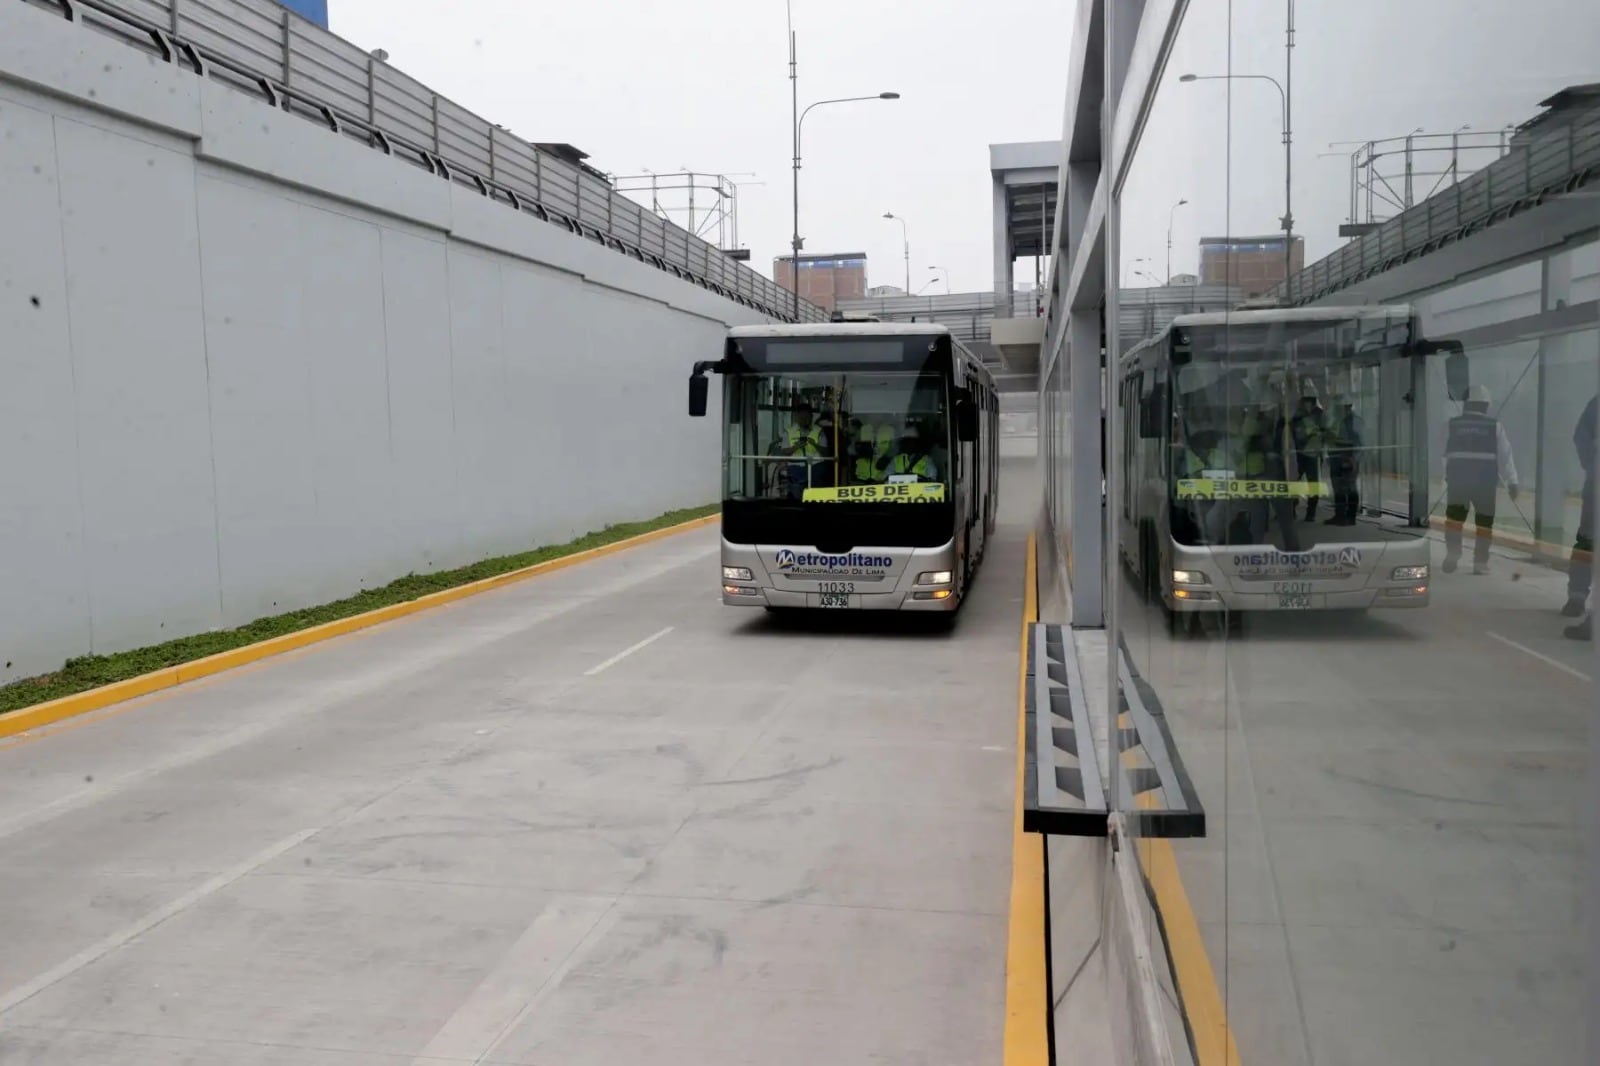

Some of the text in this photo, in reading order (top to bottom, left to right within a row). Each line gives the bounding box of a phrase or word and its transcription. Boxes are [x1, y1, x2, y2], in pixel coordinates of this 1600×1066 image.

[837, 485, 910, 498] BUS DE
[776, 549, 893, 569] Metropolitano
[818, 582, 855, 593] 11033
